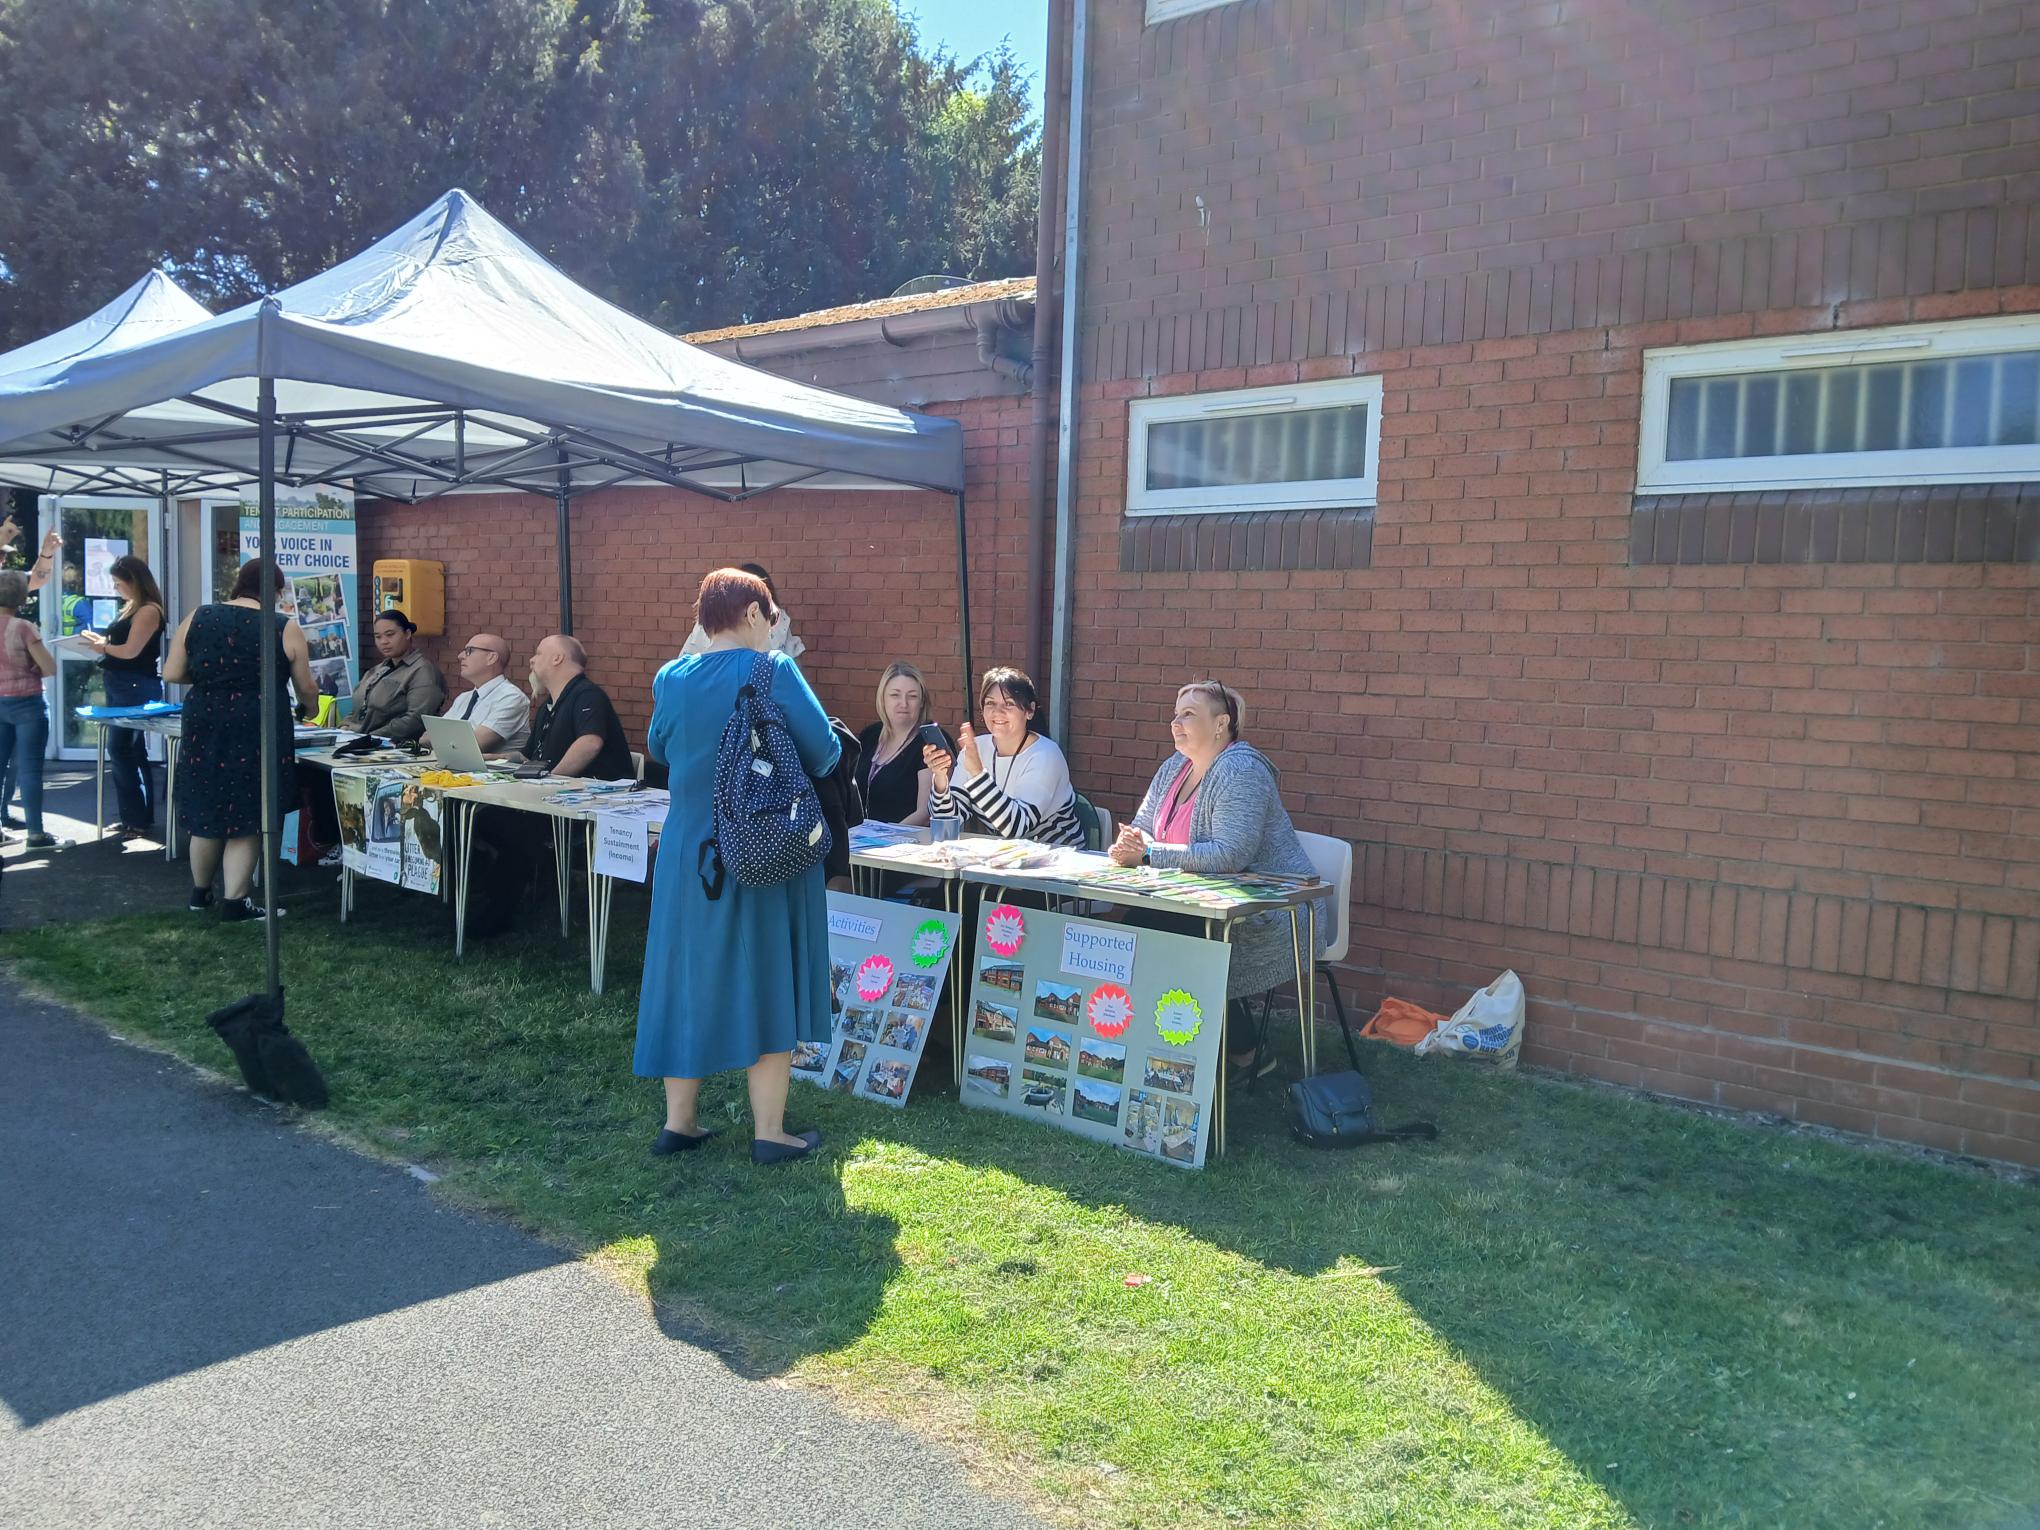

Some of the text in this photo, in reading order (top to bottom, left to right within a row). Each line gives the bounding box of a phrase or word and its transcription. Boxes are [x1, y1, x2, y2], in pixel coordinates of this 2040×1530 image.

[244, 506, 350, 519] TENT PARTICIPATION
[275, 519, 329, 531] GAGEMENT
[281, 537, 316, 551] VOICE
[320, 539, 332, 551] IN
[274, 553, 350, 568] VERY CHOICE
[609, 826, 633, 839] Tenancy
[603, 837, 640, 851] Sustainment
[407, 864, 429, 880] PLAGUE
[828, 915, 876, 936] Activities
[1064, 926, 1135, 952] Supported
[1069, 951, 1126, 980] Housing
